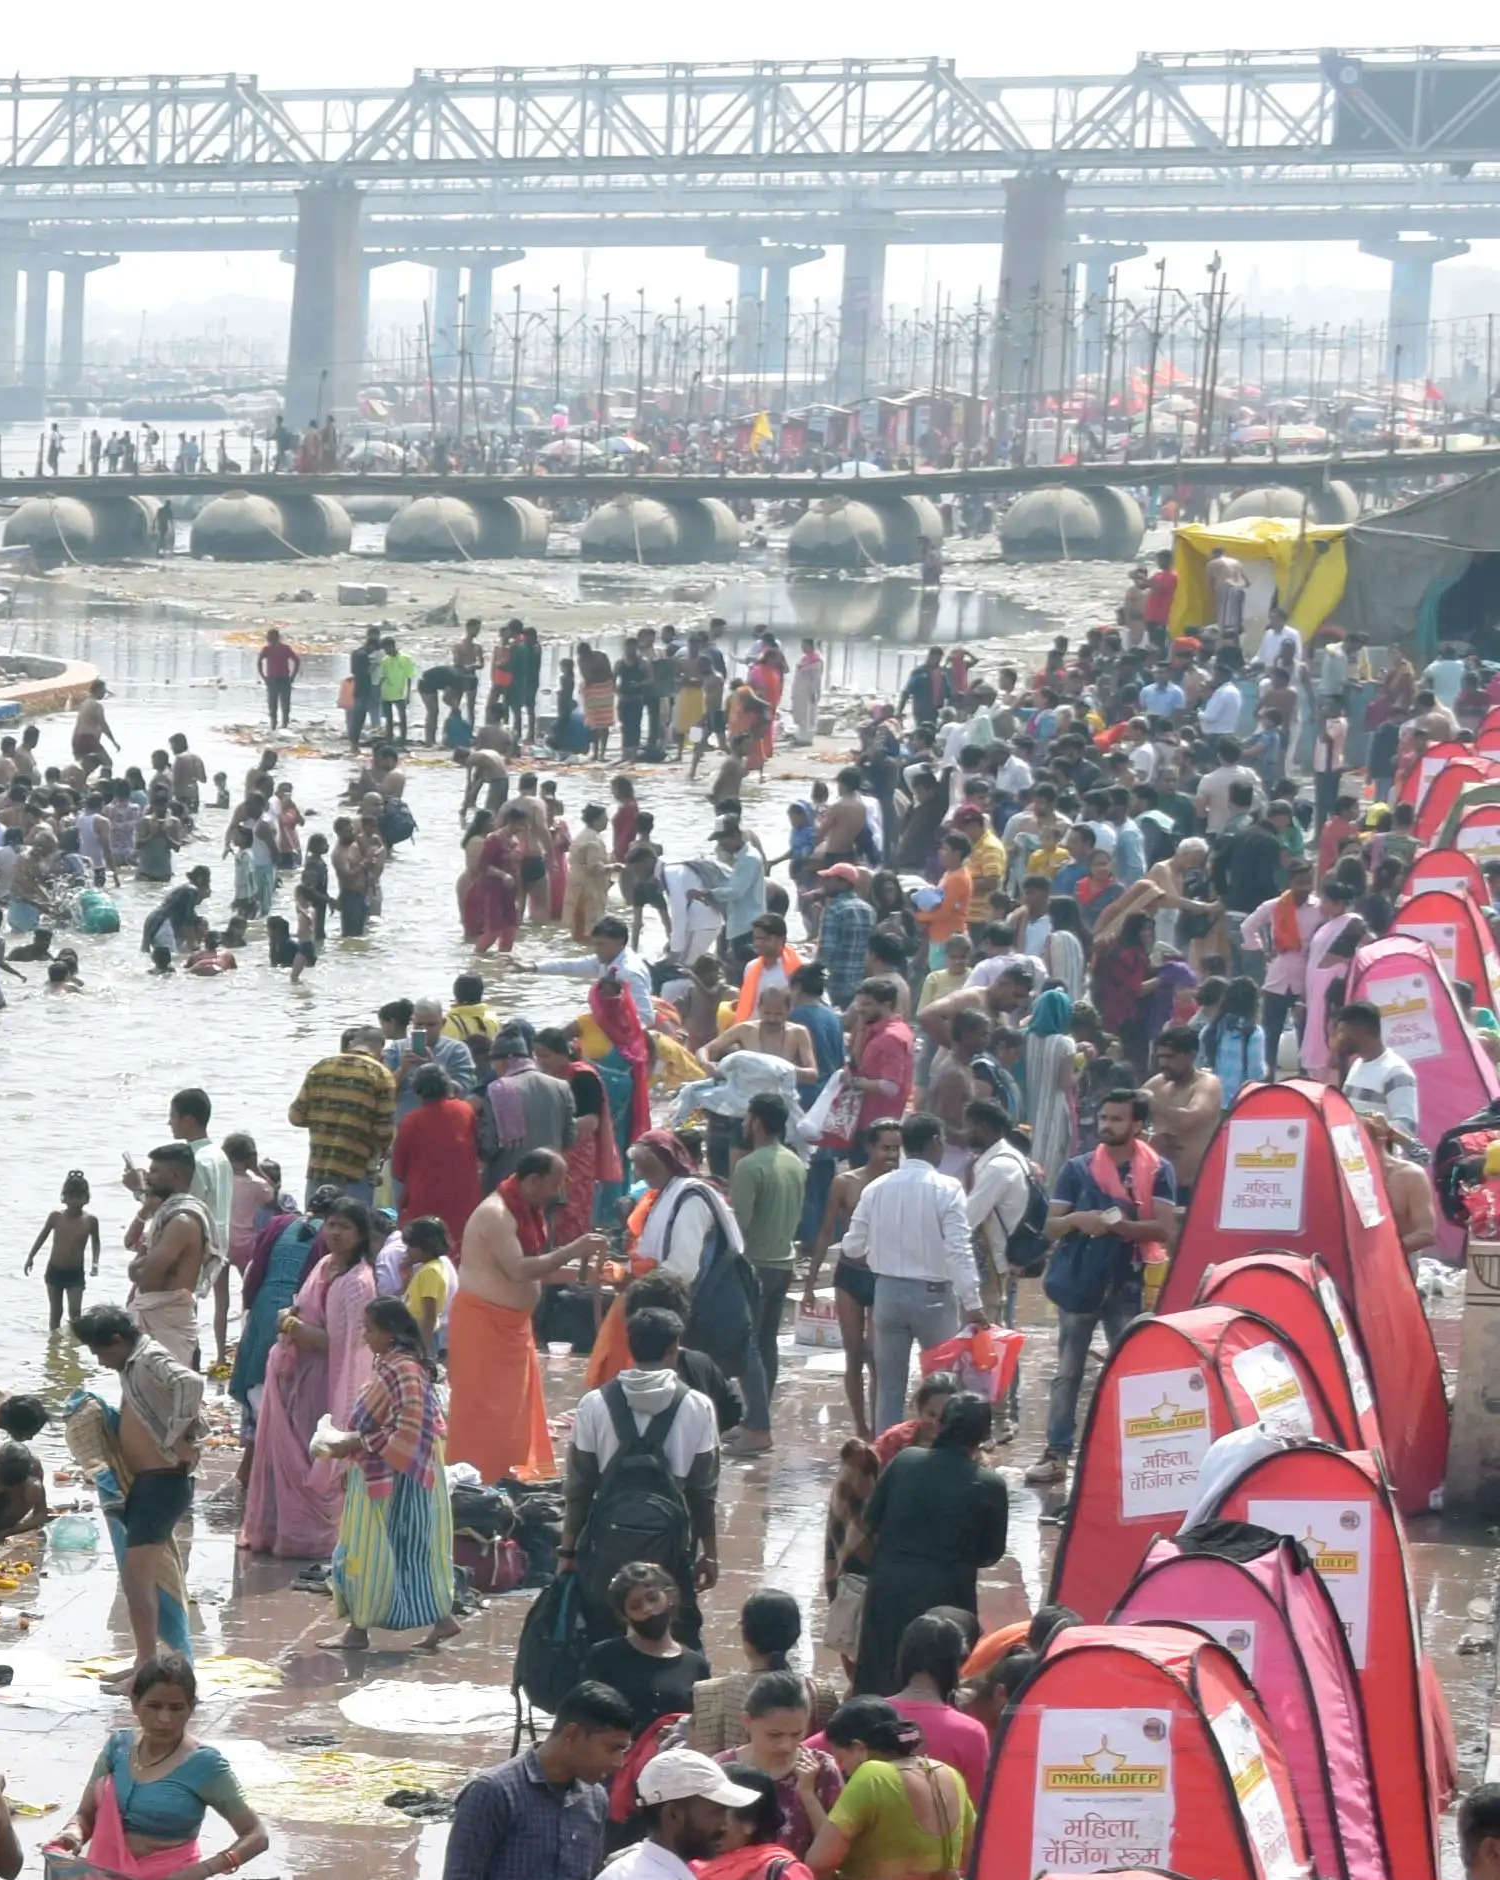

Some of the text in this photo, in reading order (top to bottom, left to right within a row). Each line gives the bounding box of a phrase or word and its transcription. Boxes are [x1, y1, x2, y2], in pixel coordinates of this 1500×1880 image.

[1052, 1772, 1158, 1785] MANGALDEEP
[1063, 1812, 1140, 1840] महिला,
[1042, 1838, 1162, 1867] चेंजिंग रूम
